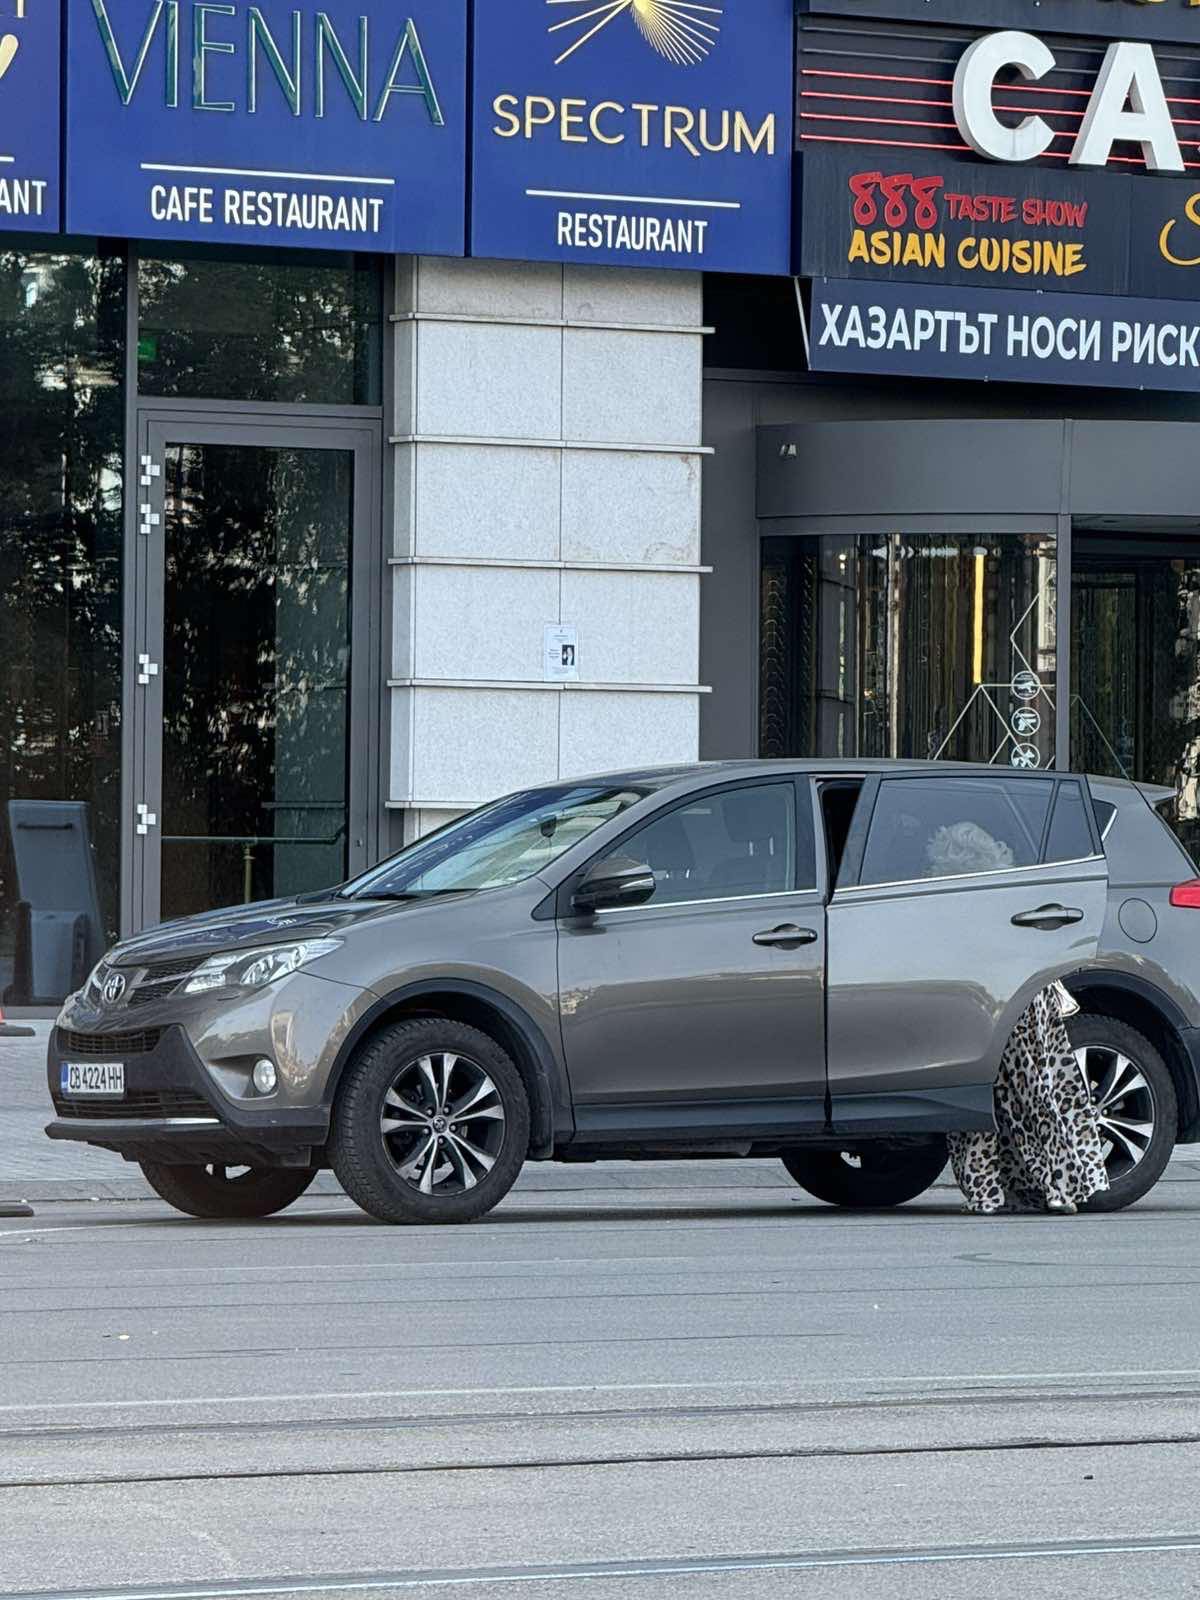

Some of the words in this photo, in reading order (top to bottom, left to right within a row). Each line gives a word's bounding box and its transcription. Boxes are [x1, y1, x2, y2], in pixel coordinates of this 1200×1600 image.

[93, 0, 444, 125] VIENNA
[492, 94, 775, 157] SPECTRUM
[151, 185, 214, 223] CAFE
[224, 189, 384, 233] RESTAURANT
[848, 171, 944, 230] 888
[944, 193, 1018, 223] TASTE
[1022, 196, 1089, 228] SHOW
[557, 211, 708, 254] RESTAURANT
[848, 229, 945, 268] ASIAN
[957, 236, 1088, 277] CUISINE
[819, 303, 998, 355] ХАЗАРТЪТ
[1006, 314, 1101, 362] НОСИ
[1111, 321, 1200, 367] РИСК
